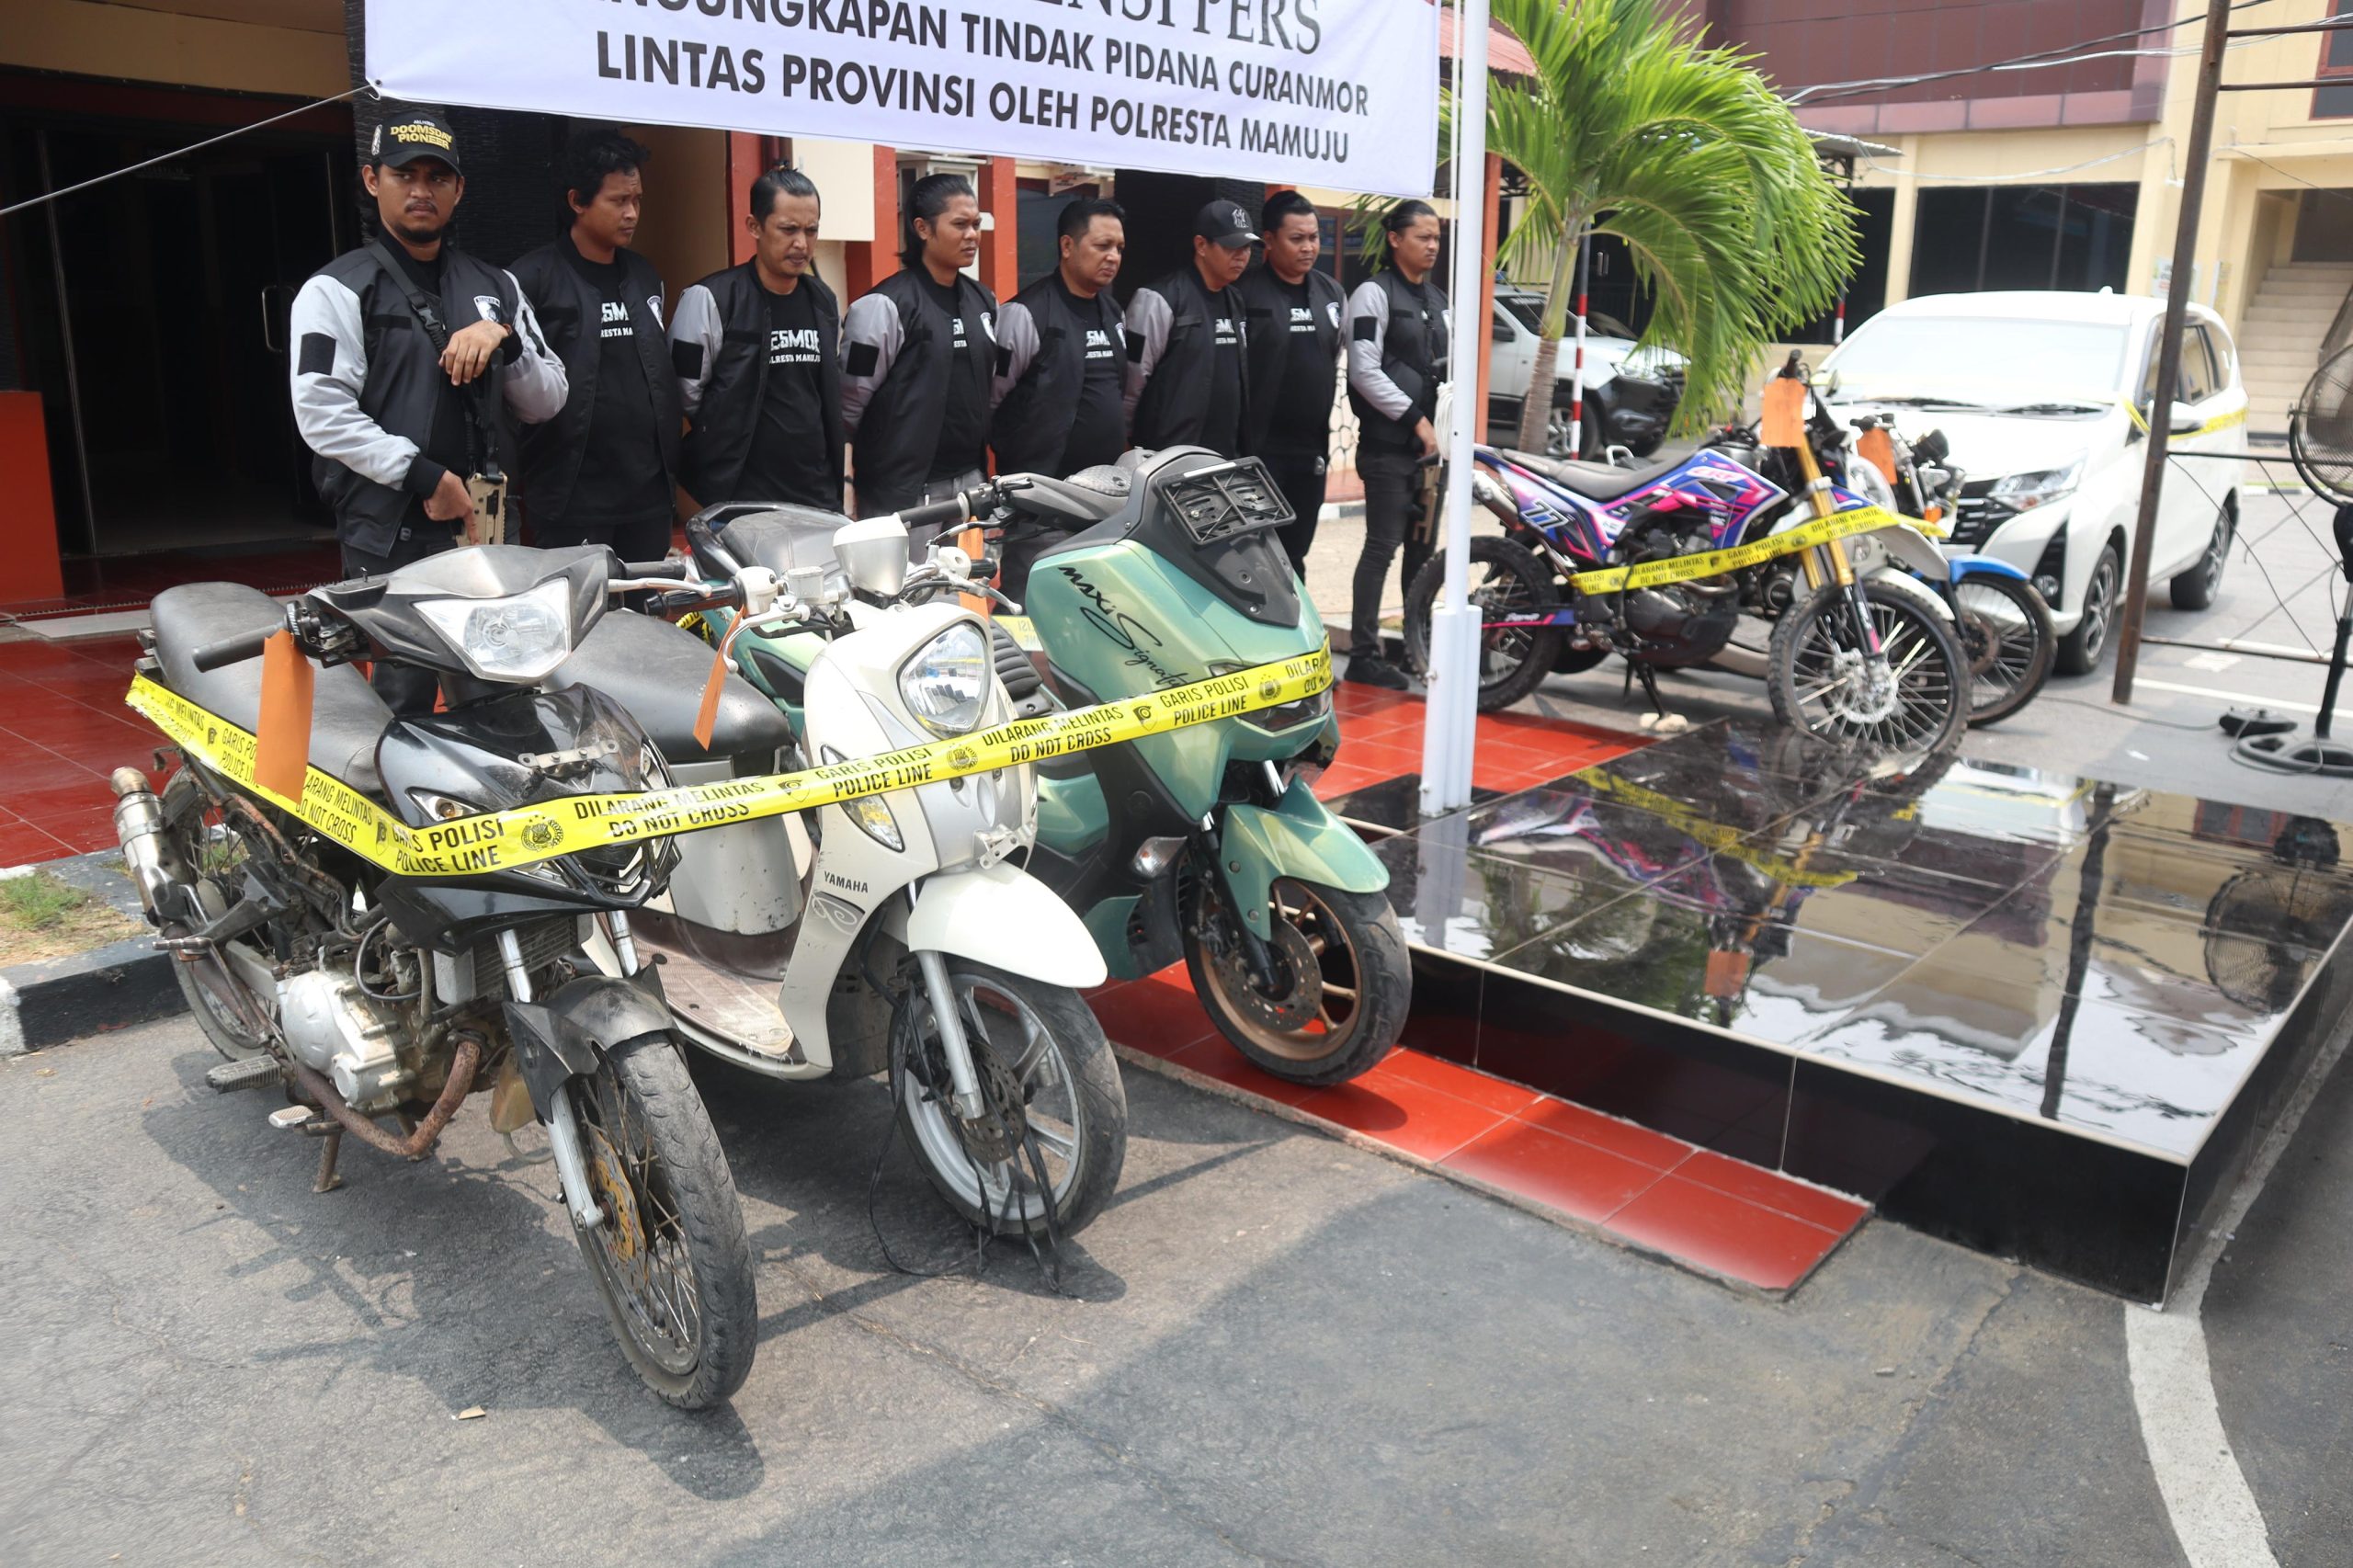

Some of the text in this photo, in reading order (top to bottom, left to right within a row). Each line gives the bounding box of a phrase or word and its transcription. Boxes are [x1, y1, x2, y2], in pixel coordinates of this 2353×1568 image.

[961, 12, 1094, 71] TINDAK
[1106, 38, 1219, 92] PIDANA
[1228, 61, 1368, 116] CURANMOR
[597, 30, 1348, 163] LINTAS PROVINSI OLEH POLRESTA MAMUJU
[390, 124, 452, 142] DOOMSDAY
[398, 133, 449, 151] PIONEER
[1160, 676, 1249, 708] GARIS POLISI
[176, 700, 205, 732] MELINTAS
[981, 706, 1124, 746] DILARANG MELINTAS
[1174, 695, 1247, 726] POLICE LINE
[222, 728, 245, 754] GARIS
[1011, 727, 1112, 763] DO NOT CROSS
[222, 750, 245, 778] POLICE
[814, 761, 871, 780] GARIS
[873, 747, 933, 768] POLISI
[832, 763, 933, 798] POLICE LINE
[302, 774, 372, 825] ARANG MELINTAS
[574, 781, 766, 819] DILARANG MELINTAS
[308, 802, 328, 825] NOT
[326, 812, 358, 844] CROSS
[608, 799, 750, 837] DO NOT CROSS
[428, 818, 505, 852] POLISI
[396, 845, 502, 872] POLICE LINE
[824, 870, 869, 893] YAMAHA
